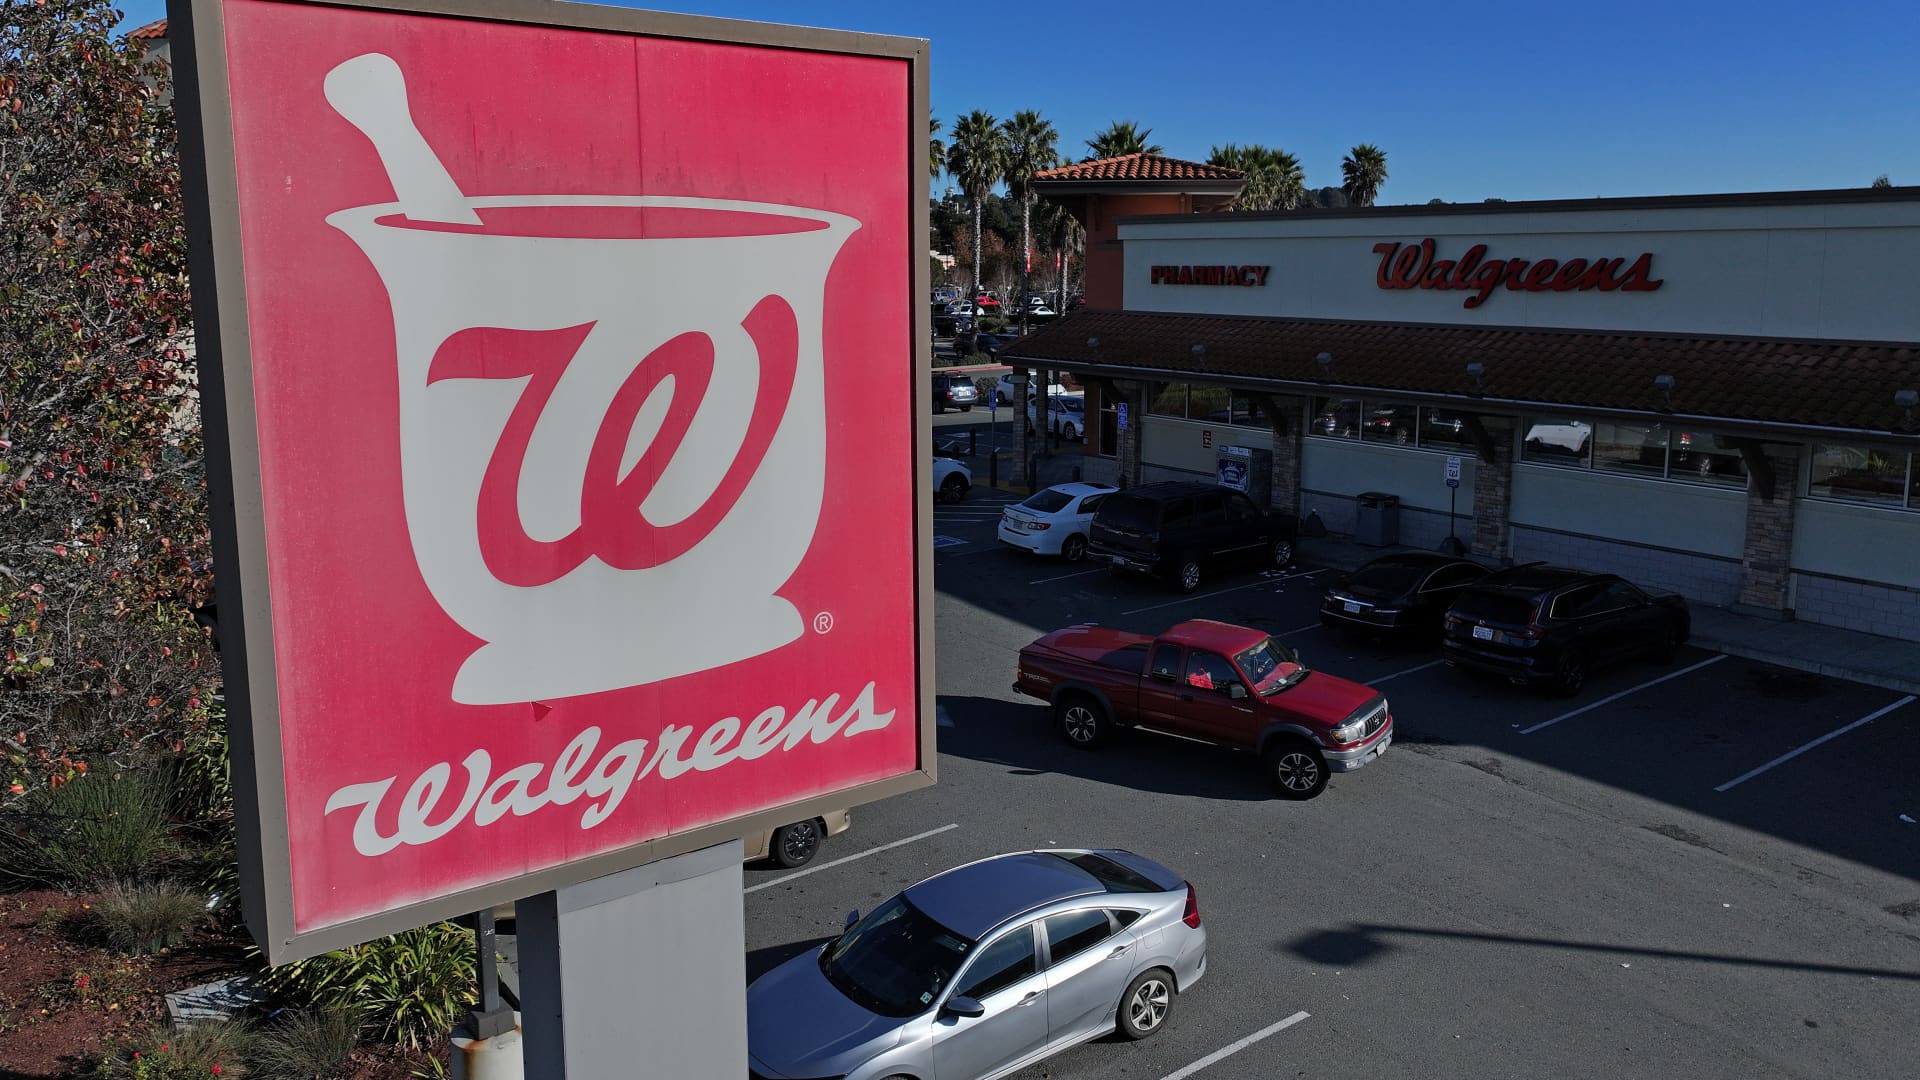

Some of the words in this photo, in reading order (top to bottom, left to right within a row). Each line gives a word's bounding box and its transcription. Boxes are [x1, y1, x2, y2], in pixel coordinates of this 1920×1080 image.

[1151, 265, 1270, 287] PHARMACY
[1372, 238, 1664, 309] Walgreens
[426, 294, 799, 588] W
[324, 681, 896, 857] Walgreens
